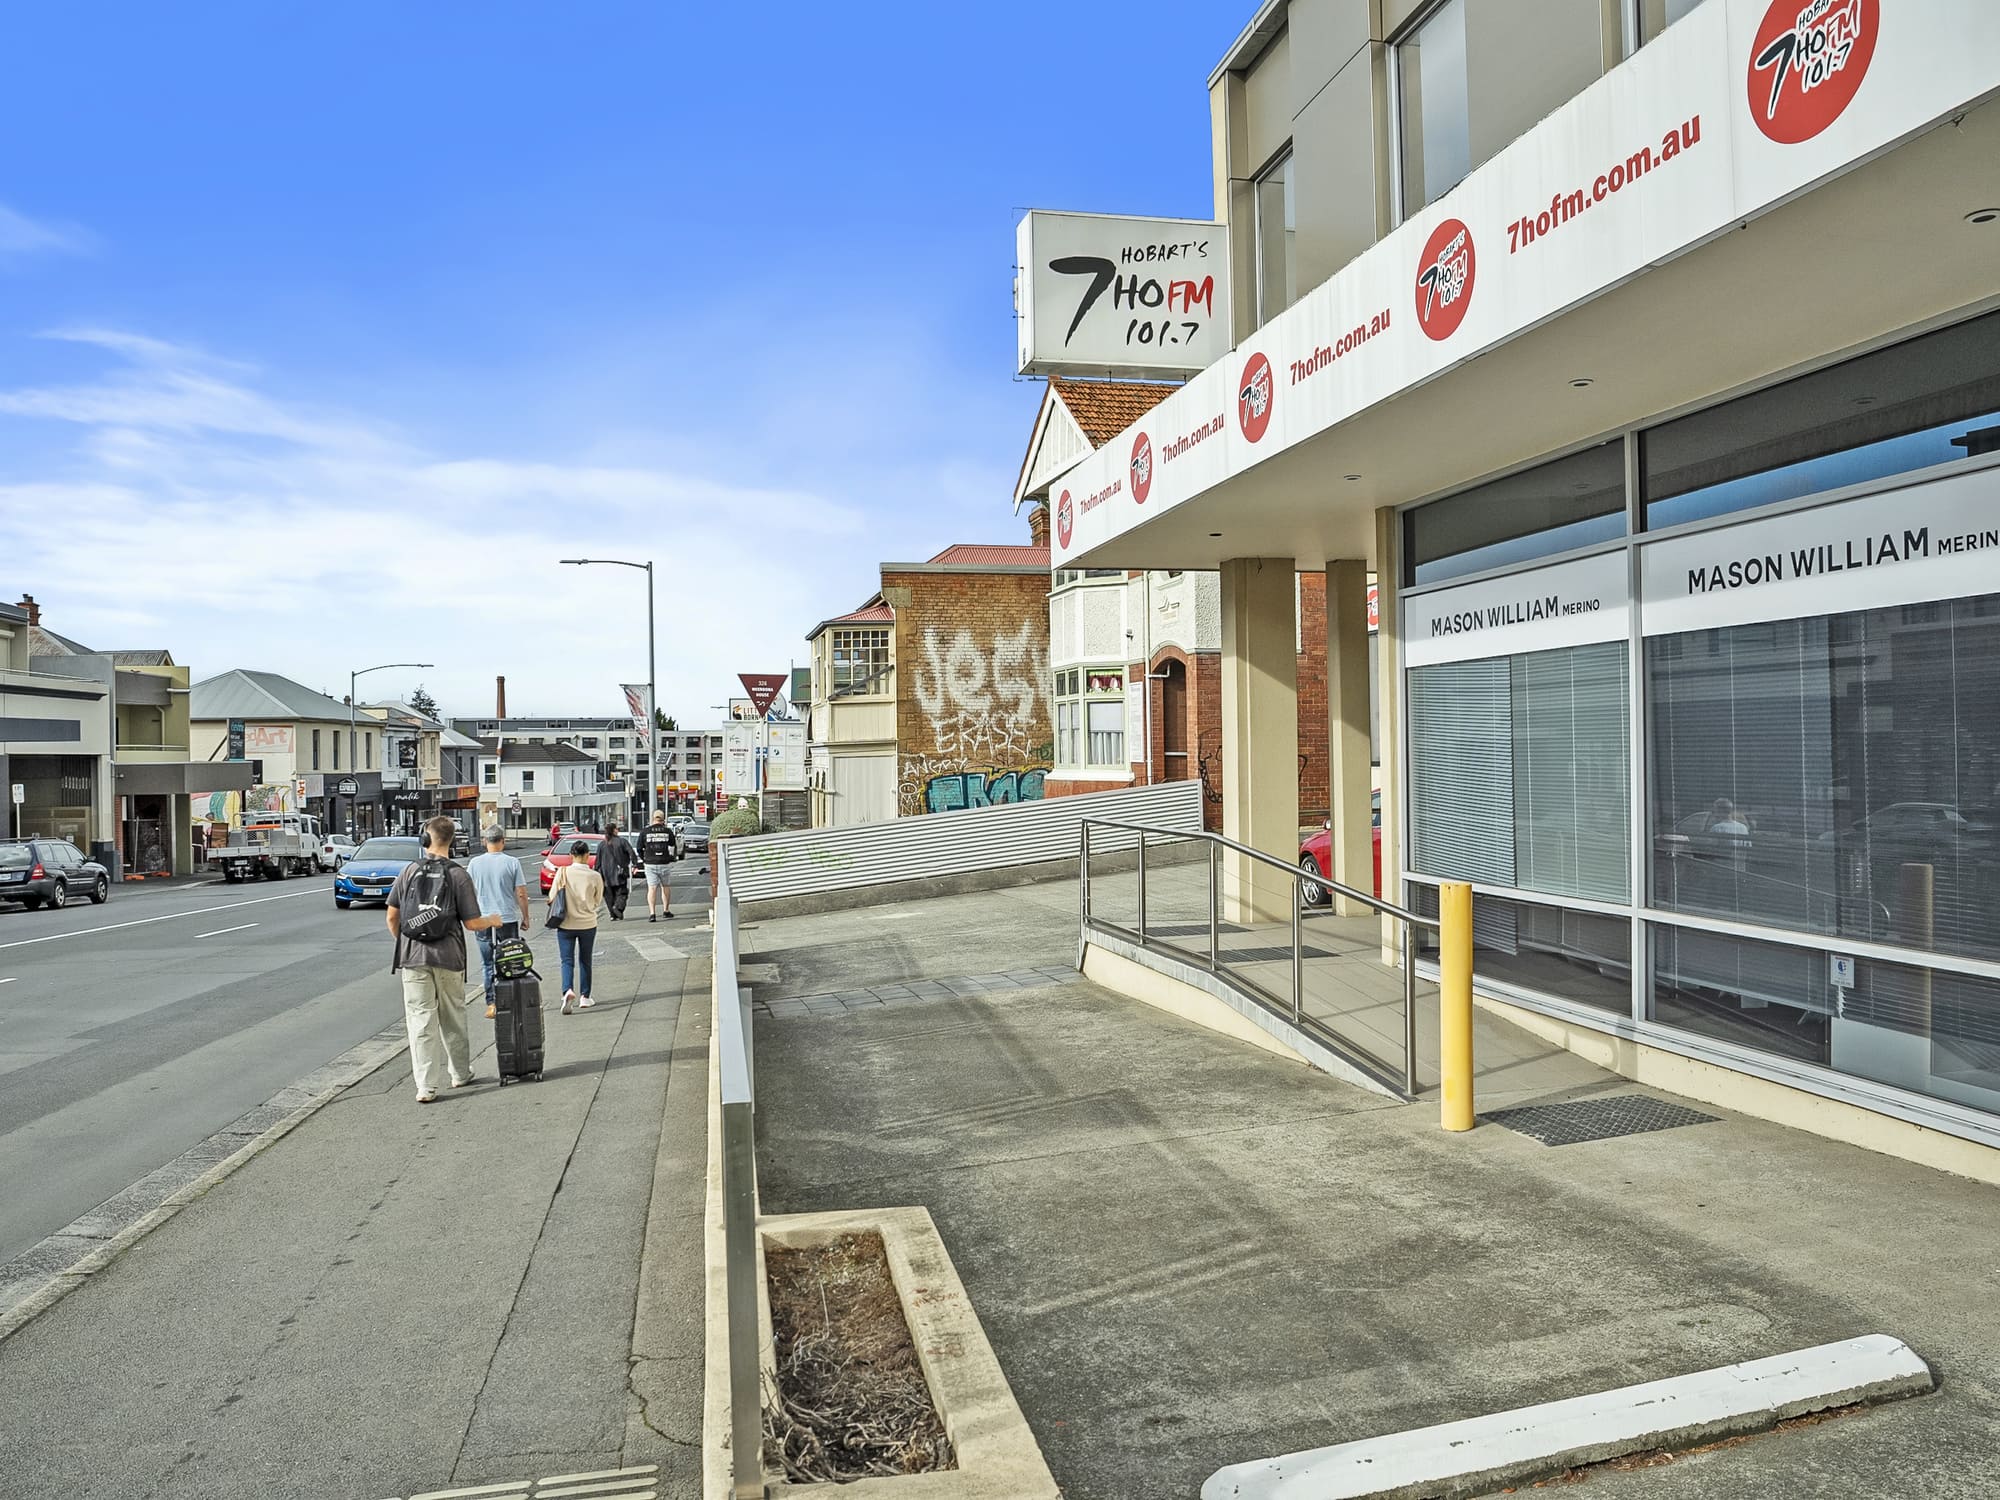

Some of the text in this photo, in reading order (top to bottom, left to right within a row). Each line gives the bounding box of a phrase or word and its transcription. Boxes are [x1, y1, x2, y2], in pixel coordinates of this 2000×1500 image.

[1804, 42, 1850, 89] 101.7
[1507, 114, 1701, 254] 7hofm.com.au
[1121, 240, 1209, 264] HOBART'S
[1049, 256, 1214, 348] 7HOFM
[1126, 319, 1199, 347] 101.7
[1290, 307, 1391, 386] 7hofm.com.au
[1162, 413, 1225, 464] 7hofm.com.au
[1080, 479, 1122, 516] 7hofm.com.au
[1688, 527, 2000, 595] MASON WILLIAM MERIN
[1431, 595, 1601, 638] MASON WILLIAM MERINO
